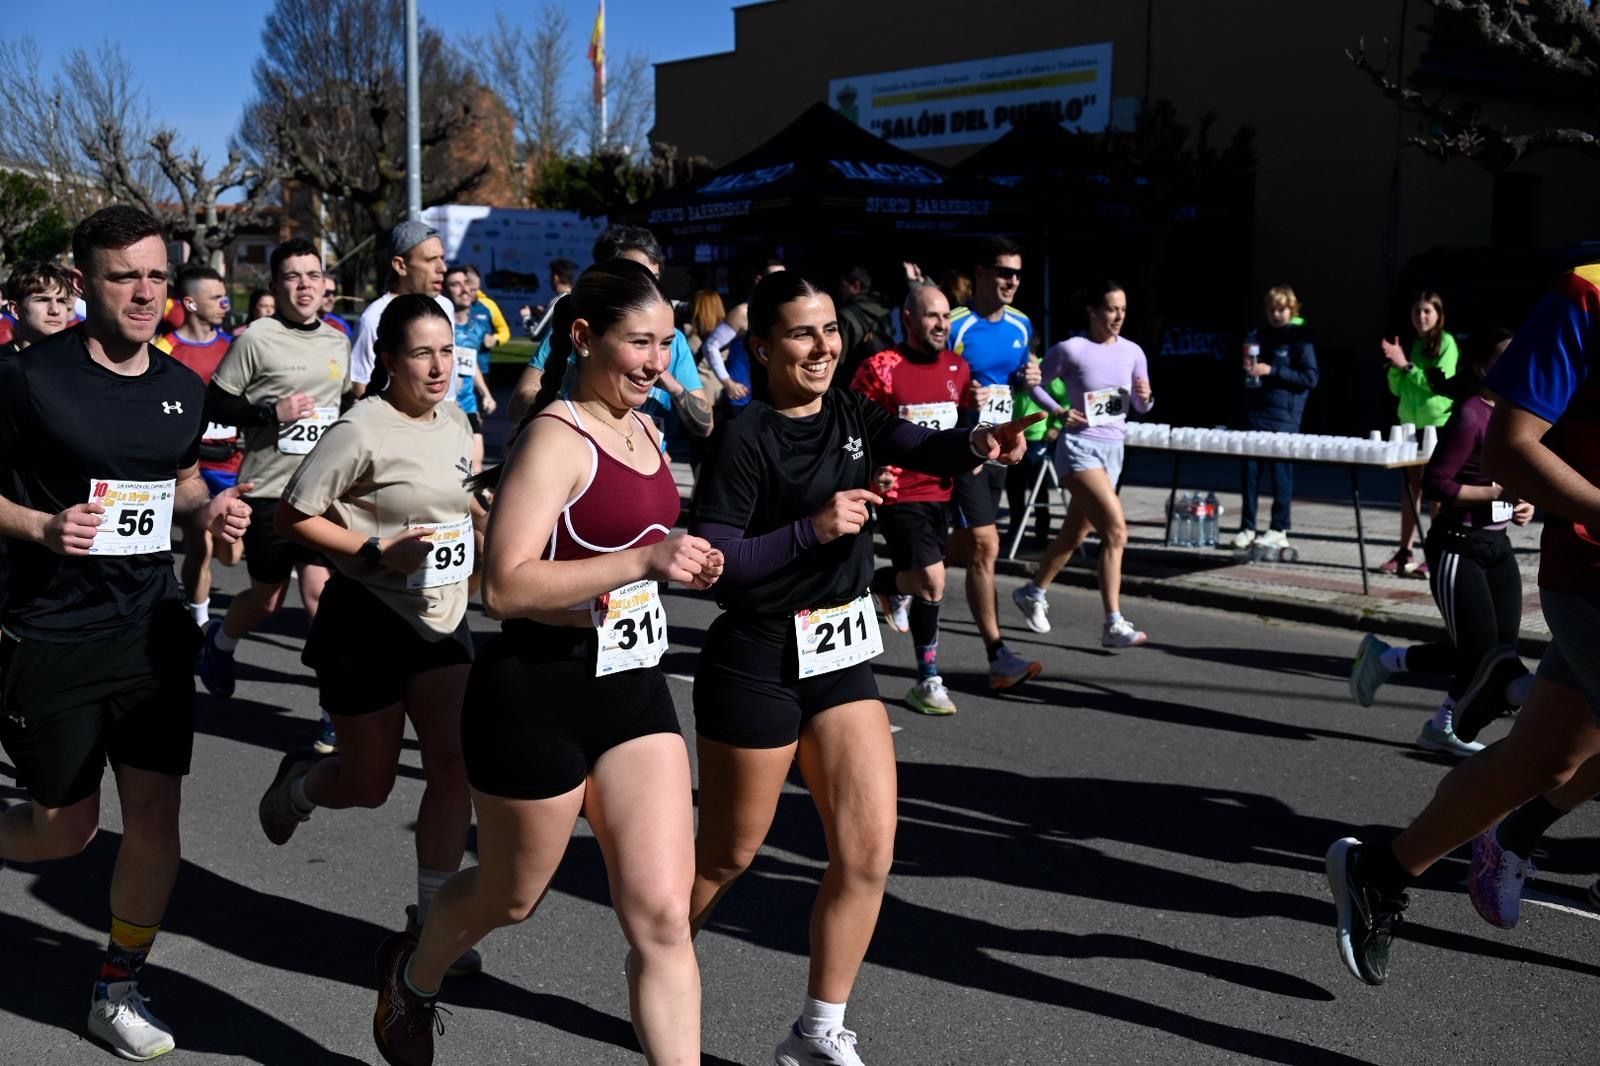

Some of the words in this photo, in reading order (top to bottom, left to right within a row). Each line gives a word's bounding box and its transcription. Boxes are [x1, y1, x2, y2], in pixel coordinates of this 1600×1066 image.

[952, 107, 988, 134] DEL
[865, 196, 911, 213] SPORTS
[116, 508, 156, 537] 56
[435, 543, 466, 570] 93
[815, 611, 868, 654] 211
